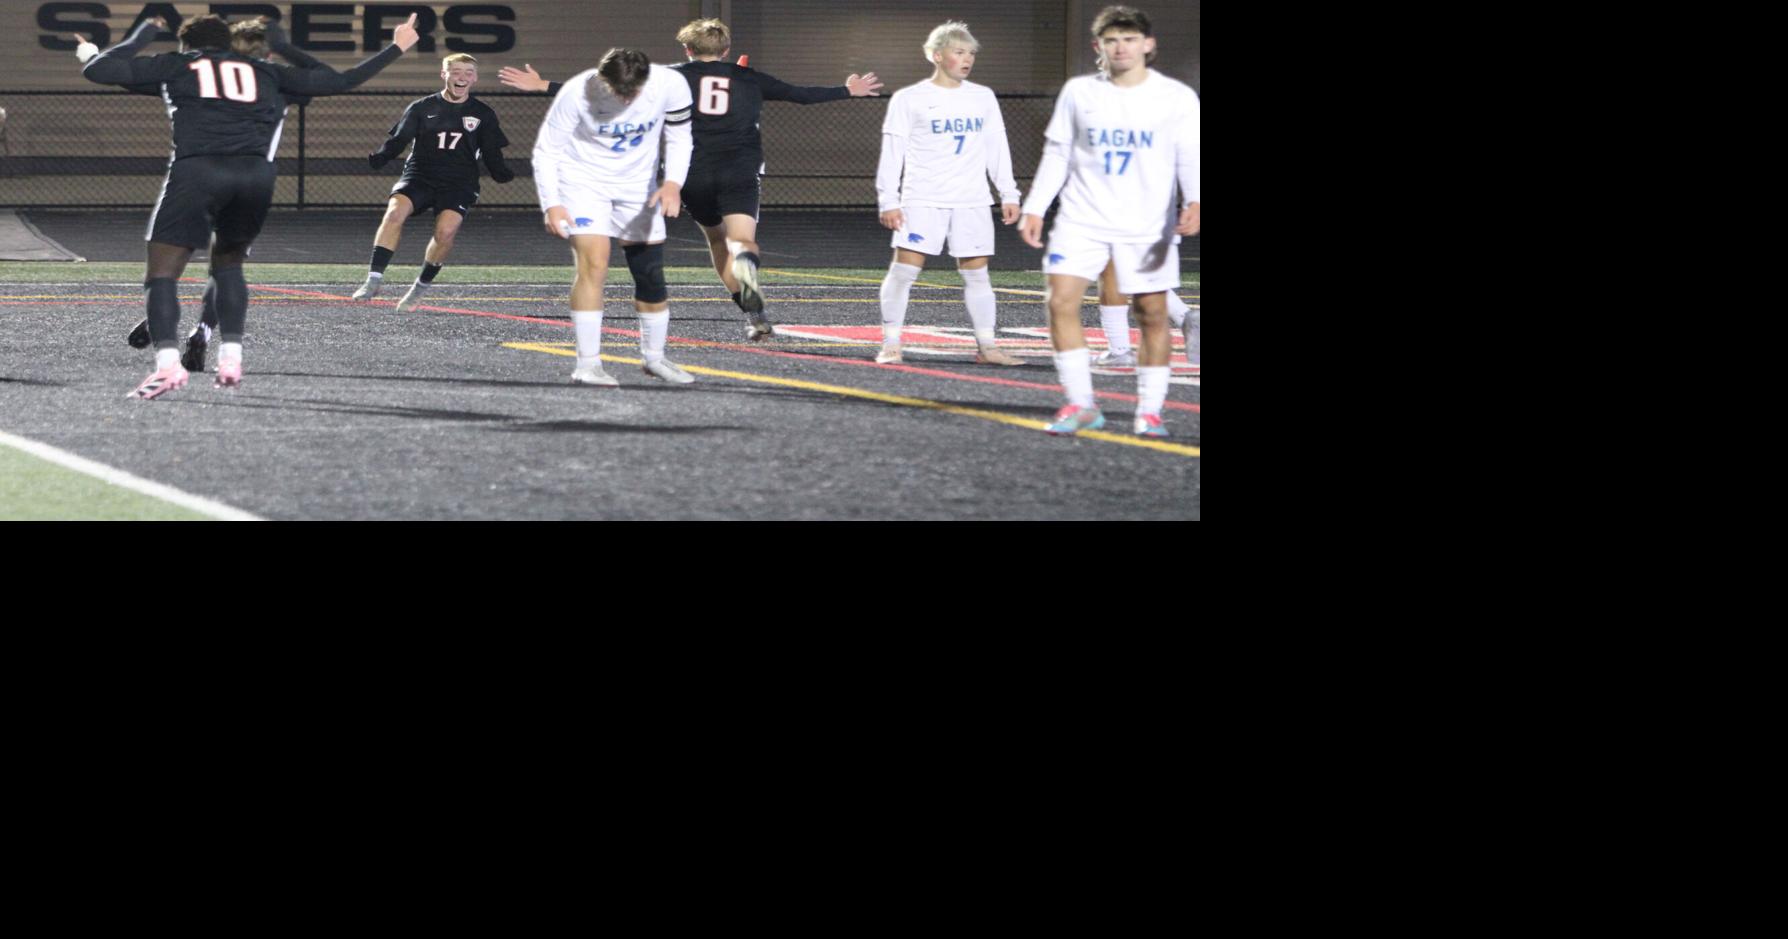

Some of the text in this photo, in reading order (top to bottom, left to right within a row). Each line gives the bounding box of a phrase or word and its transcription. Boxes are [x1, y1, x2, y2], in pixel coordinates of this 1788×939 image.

[187, 58, 258, 103] 10
[699, 76, 730, 115] 6
[931, 117, 984, 134] EAGAN
[437, 131, 463, 150] 17
[953, 135, 966, 155] 7
[1086, 127, 1153, 149] EAGAN
[1103, 150, 1133, 176] 17
